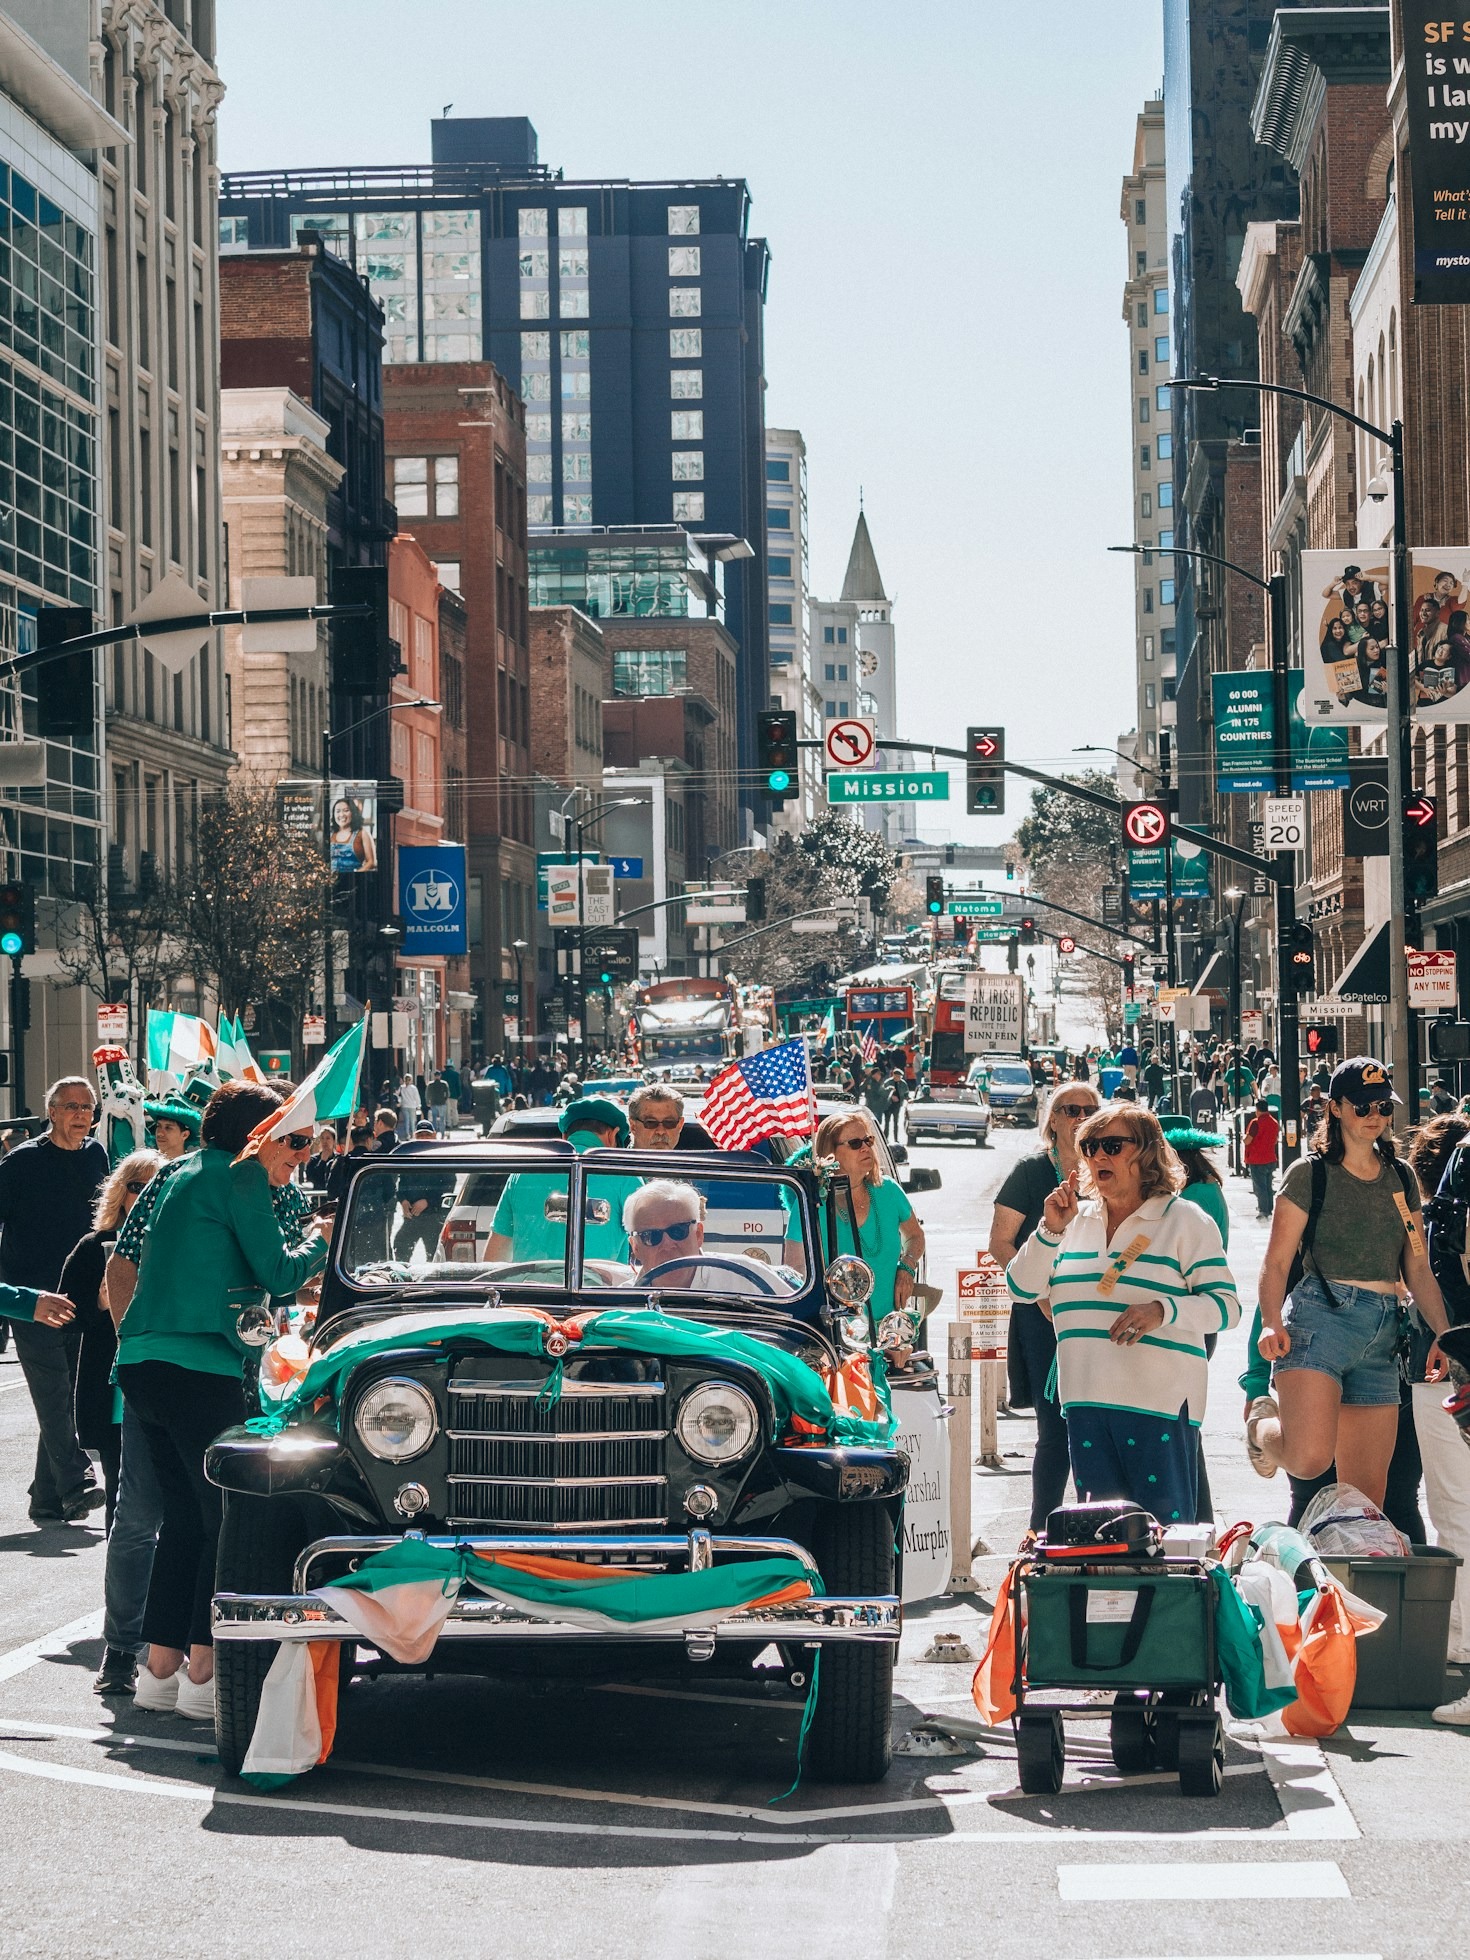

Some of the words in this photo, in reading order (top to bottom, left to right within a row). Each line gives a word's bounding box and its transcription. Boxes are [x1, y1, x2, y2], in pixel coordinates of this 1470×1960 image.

[1424, 22, 1455, 43] SF
[1425, 52, 1447, 75] is
[1428, 86, 1435, 107] I
[1443, 84, 1470, 107] la
[1429, 121, 1469, 144] my
[1434, 208, 1455, 221] Tell
[1458, 208, 1467, 221] it
[1229, 690, 1240, 699] 60
[1241, 689, 1259, 699] 000
[1226, 703, 1262, 714] ALUMNI
[1231, 718, 1242, 727] IN
[1243, 718, 1259, 727] 175
[1220, 731, 1272, 741] COUNTRIES
[844, 779, 934, 796] Mission
[1268, 804, 1301, 813] SPEED
[1355, 799, 1387, 812] WRT
[1271, 815, 1298, 823] LIMIT
[1270, 825, 1300, 844] 20
[588, 896, 605, 905] THE
[587, 905, 610, 914] EAST
[954, 904, 996, 913] Natoma
[587, 914, 607, 923] CUT
[406, 924, 460, 933] MALCOLM
[1410, 967, 1424, 976] NO
[1425, 967, 1453, 976] STOPPING
[1414, 981, 1430, 991] ANY
[1431, 981, 1450, 991] TIME
[505, 994, 519, 1004] sg
[972, 988, 985, 1004] AN
[989, 989, 1015, 1005] IRISH
[1352, 993, 1388, 1002] Patelco
[970, 1005, 1018, 1022] REPUBLIC
[1309, 1006, 1353, 1014] Mission
[968, 1031, 992, 1040] SINN
[1361, 1064, 1386, 1085] Cal
[743, 1222, 764, 1233] PIO
[961, 1288, 974, 1296] NO
[976, 1288, 1008, 1296] STOPPIN
[904, 1471, 941, 1504] arshal
[904, 1520, 950, 1560] Murphy
